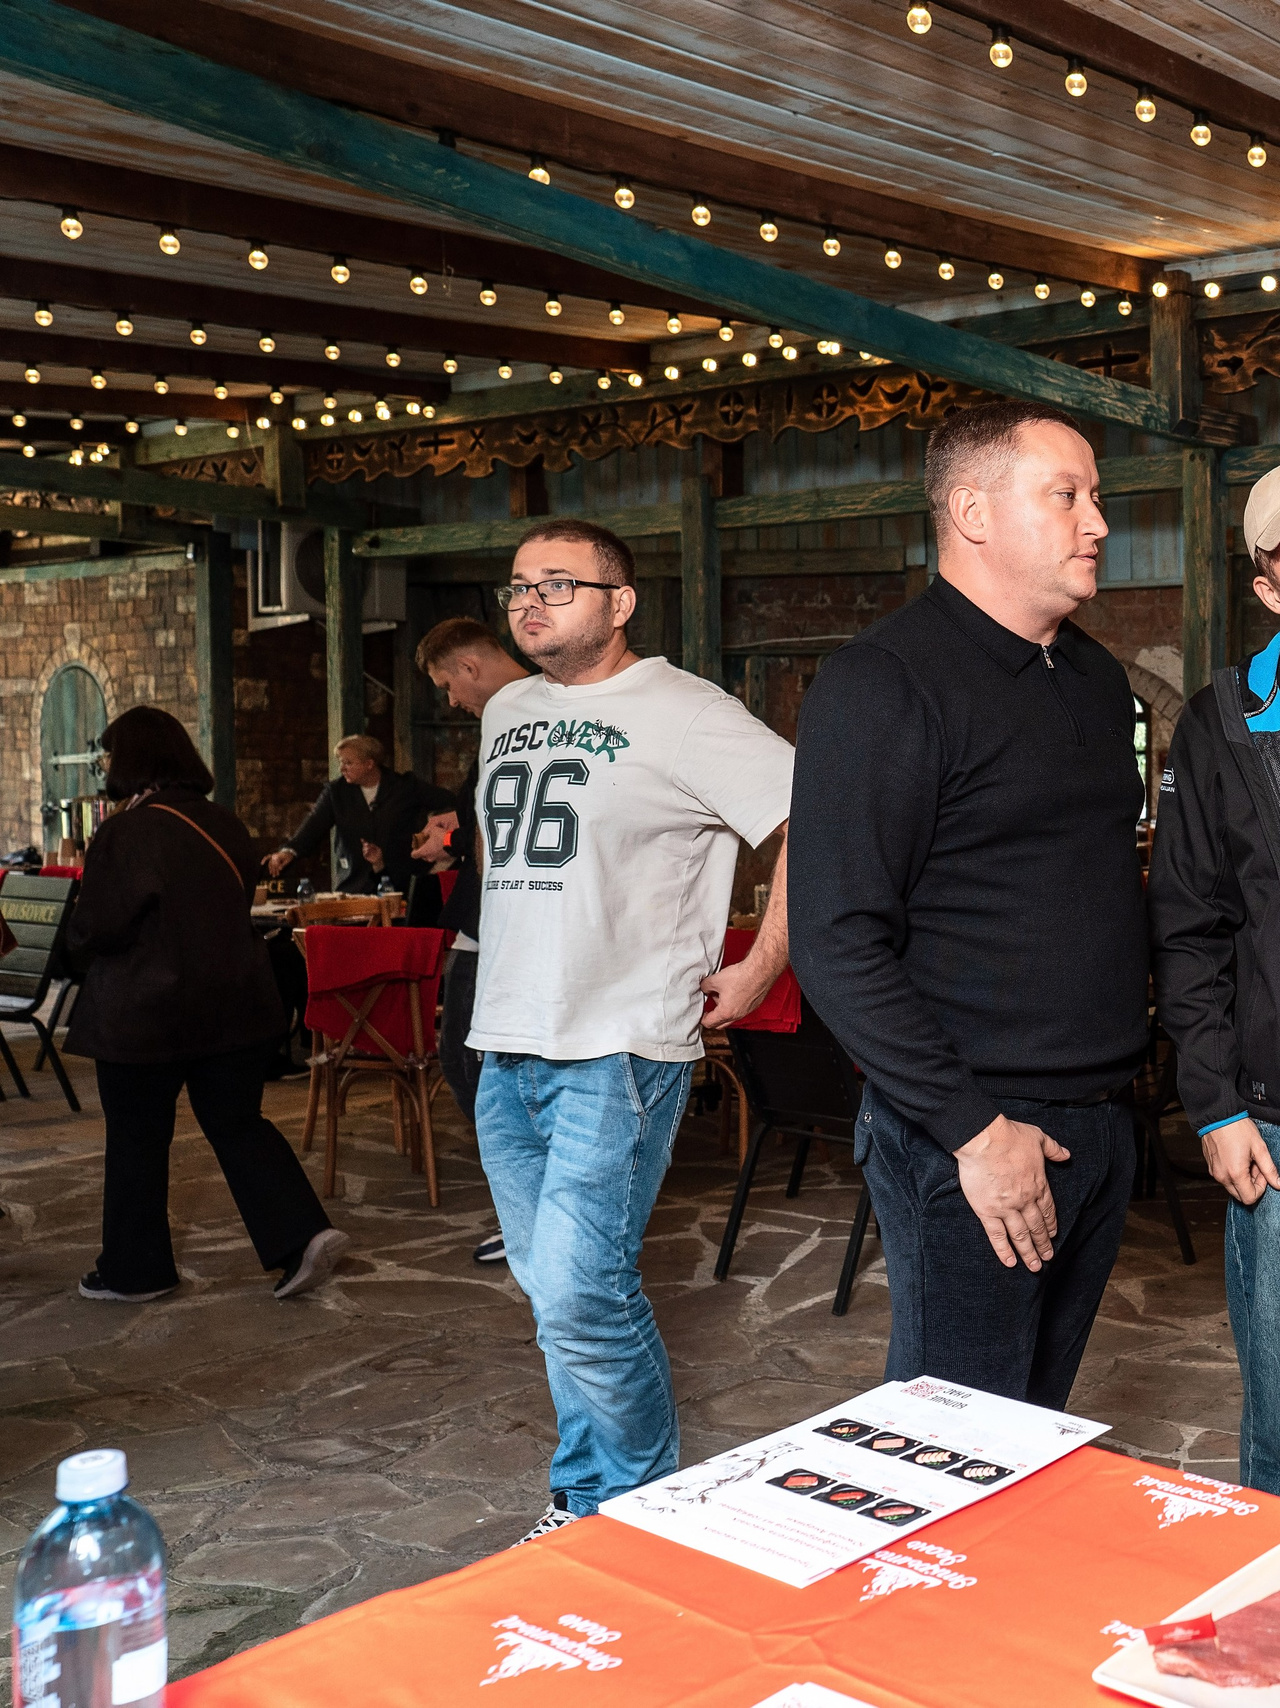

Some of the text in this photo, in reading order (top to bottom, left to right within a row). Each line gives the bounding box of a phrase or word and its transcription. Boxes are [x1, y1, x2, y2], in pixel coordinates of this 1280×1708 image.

[483, 758, 590, 869] 86
[528, 880, 564, 892] SUCESS
[1132, 1474, 1260, 1517] Открытый
[1182, 1472, 1244, 1495] Огонь
[906, 1540, 968, 1566] Огонь
[490, 1614, 623, 1672] Открытый
[557, 1613, 622, 1646] Огонь
